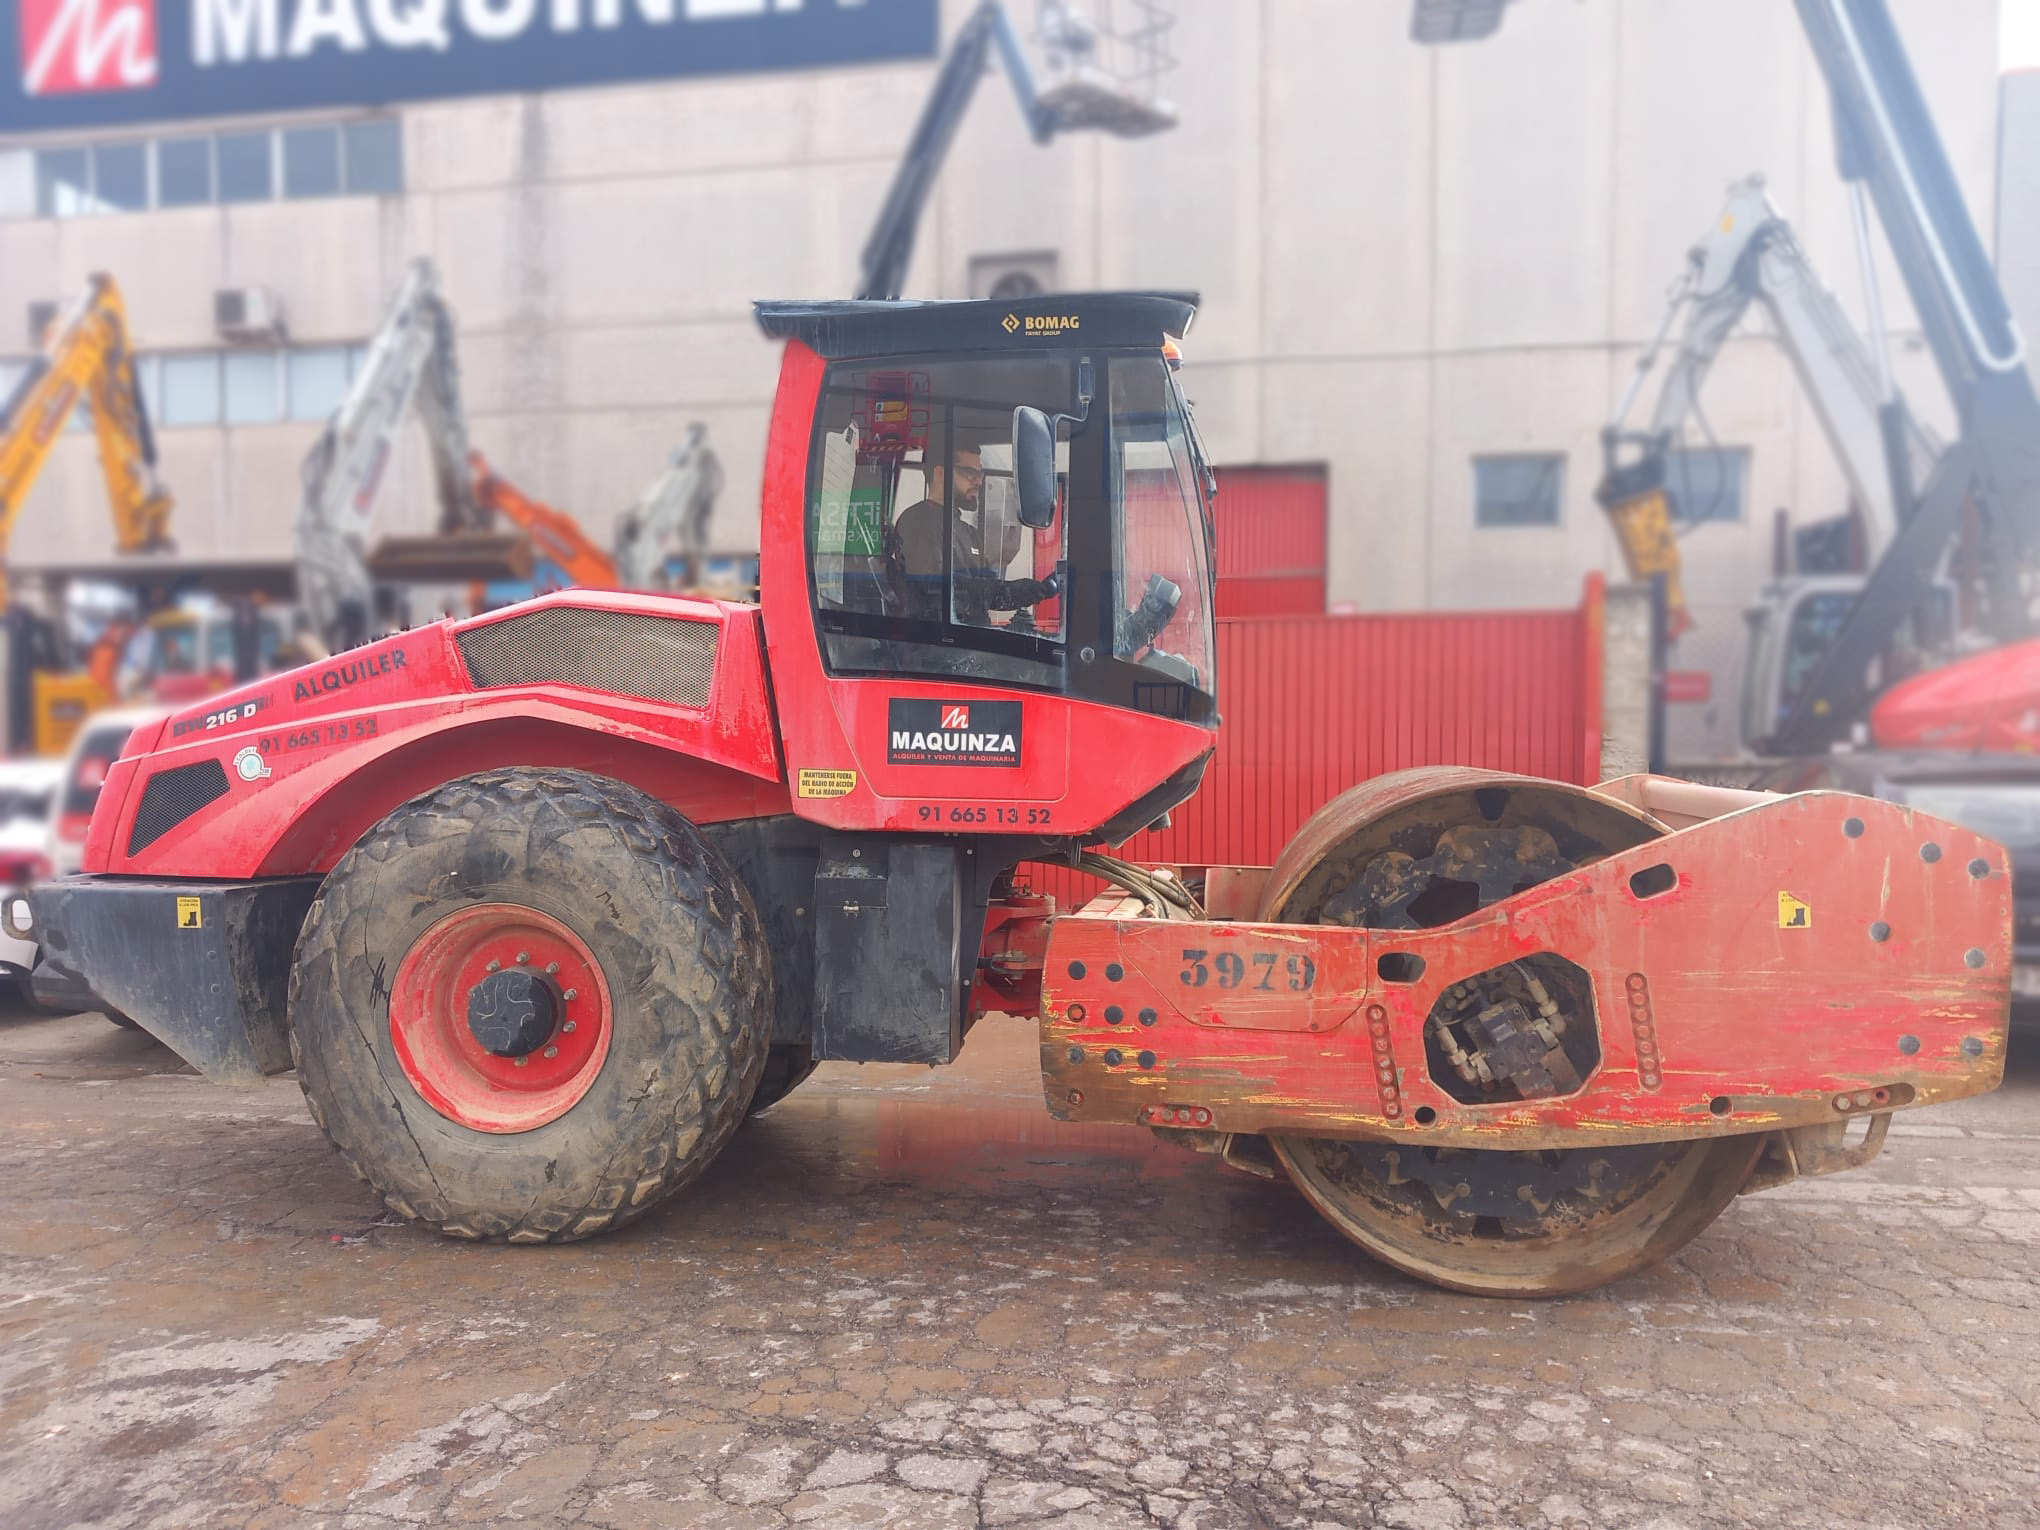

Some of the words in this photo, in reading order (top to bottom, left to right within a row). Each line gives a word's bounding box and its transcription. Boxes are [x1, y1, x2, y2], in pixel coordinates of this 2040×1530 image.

[1025, 316, 1080, 329] BOMAG
[295, 649, 407, 702] ALQUILER
[206, 709, 238, 730] 216
[244, 703, 257, 719] D
[261, 736, 280, 752] 91
[288, 729, 320, 749] 665
[328, 724, 349, 741] 13
[355, 719, 377, 736] 52
[892, 731, 1016, 752] MAQUINZA
[804, 771, 836, 779] MANTENERSE
[812, 780, 828, 788] RADIO
[918, 806, 941, 822] 91
[950, 807, 987, 823] 665
[997, 808, 1019, 824] 13
[1028, 808, 1051, 825] 52
[1180, 949, 1316, 992] 3979
